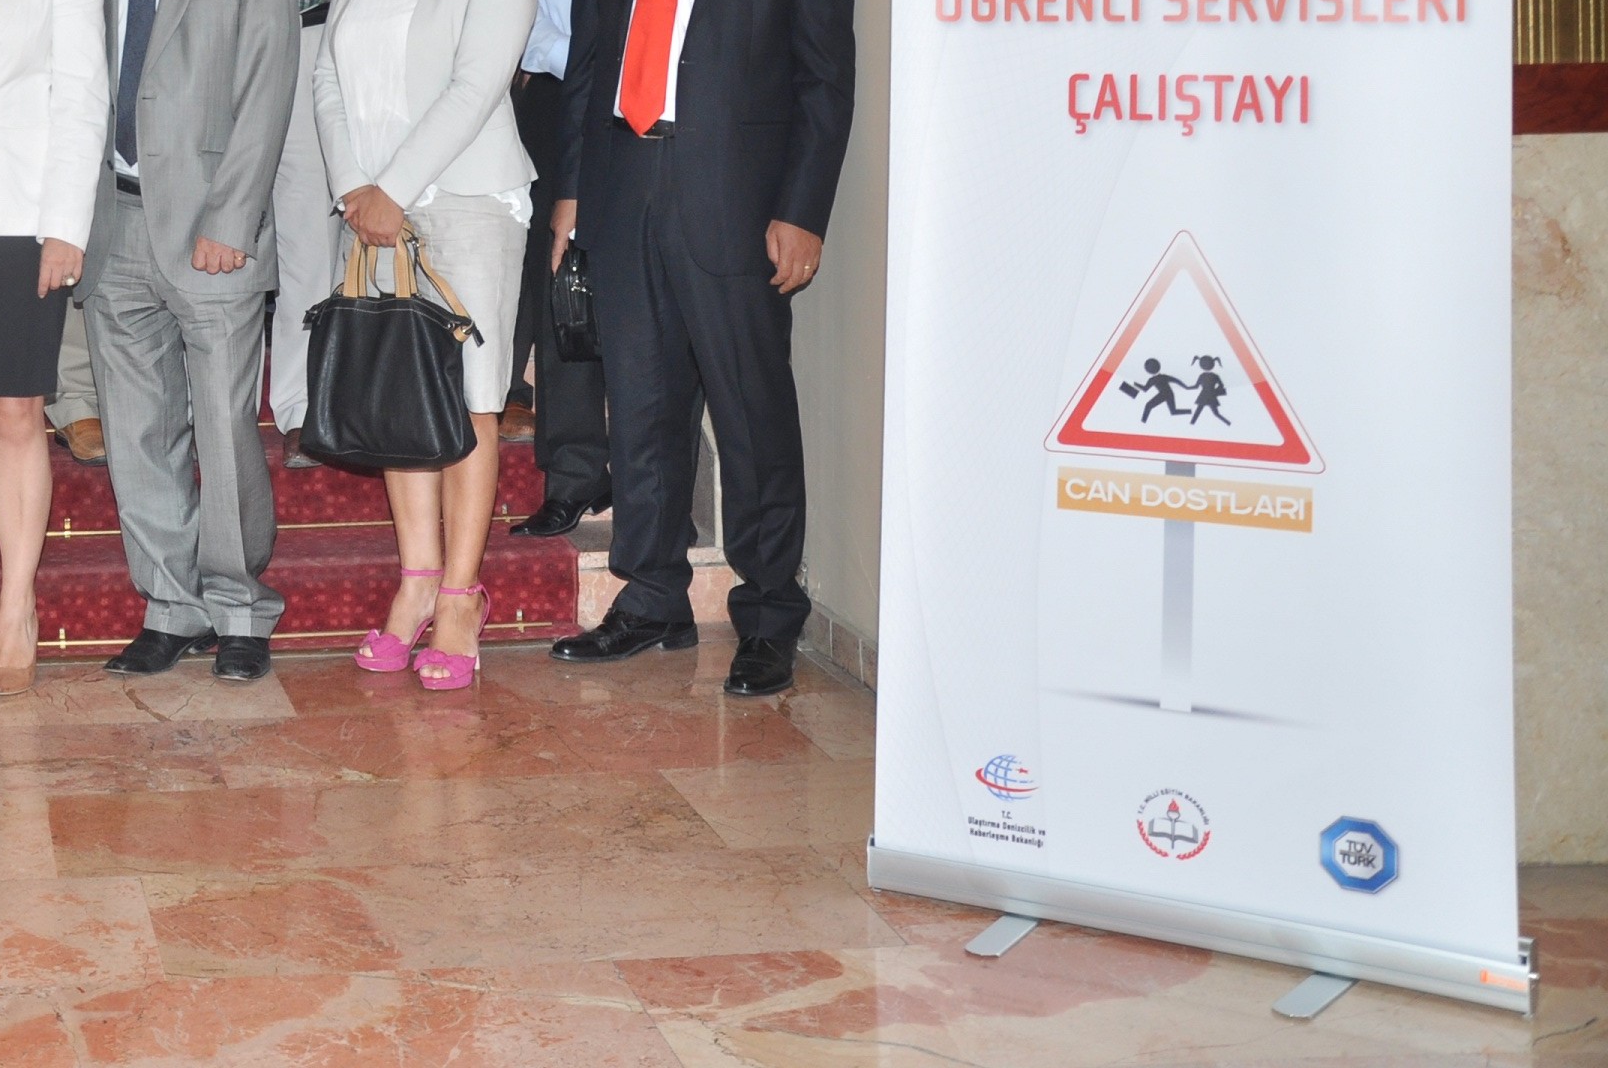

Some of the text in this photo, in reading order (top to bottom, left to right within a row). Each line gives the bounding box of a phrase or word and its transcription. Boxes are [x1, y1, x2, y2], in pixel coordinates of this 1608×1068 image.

[1067, 73, 1310, 136] ÇALIŞTAYI
[1065, 478, 1305, 520] CAN DOSTLARI
